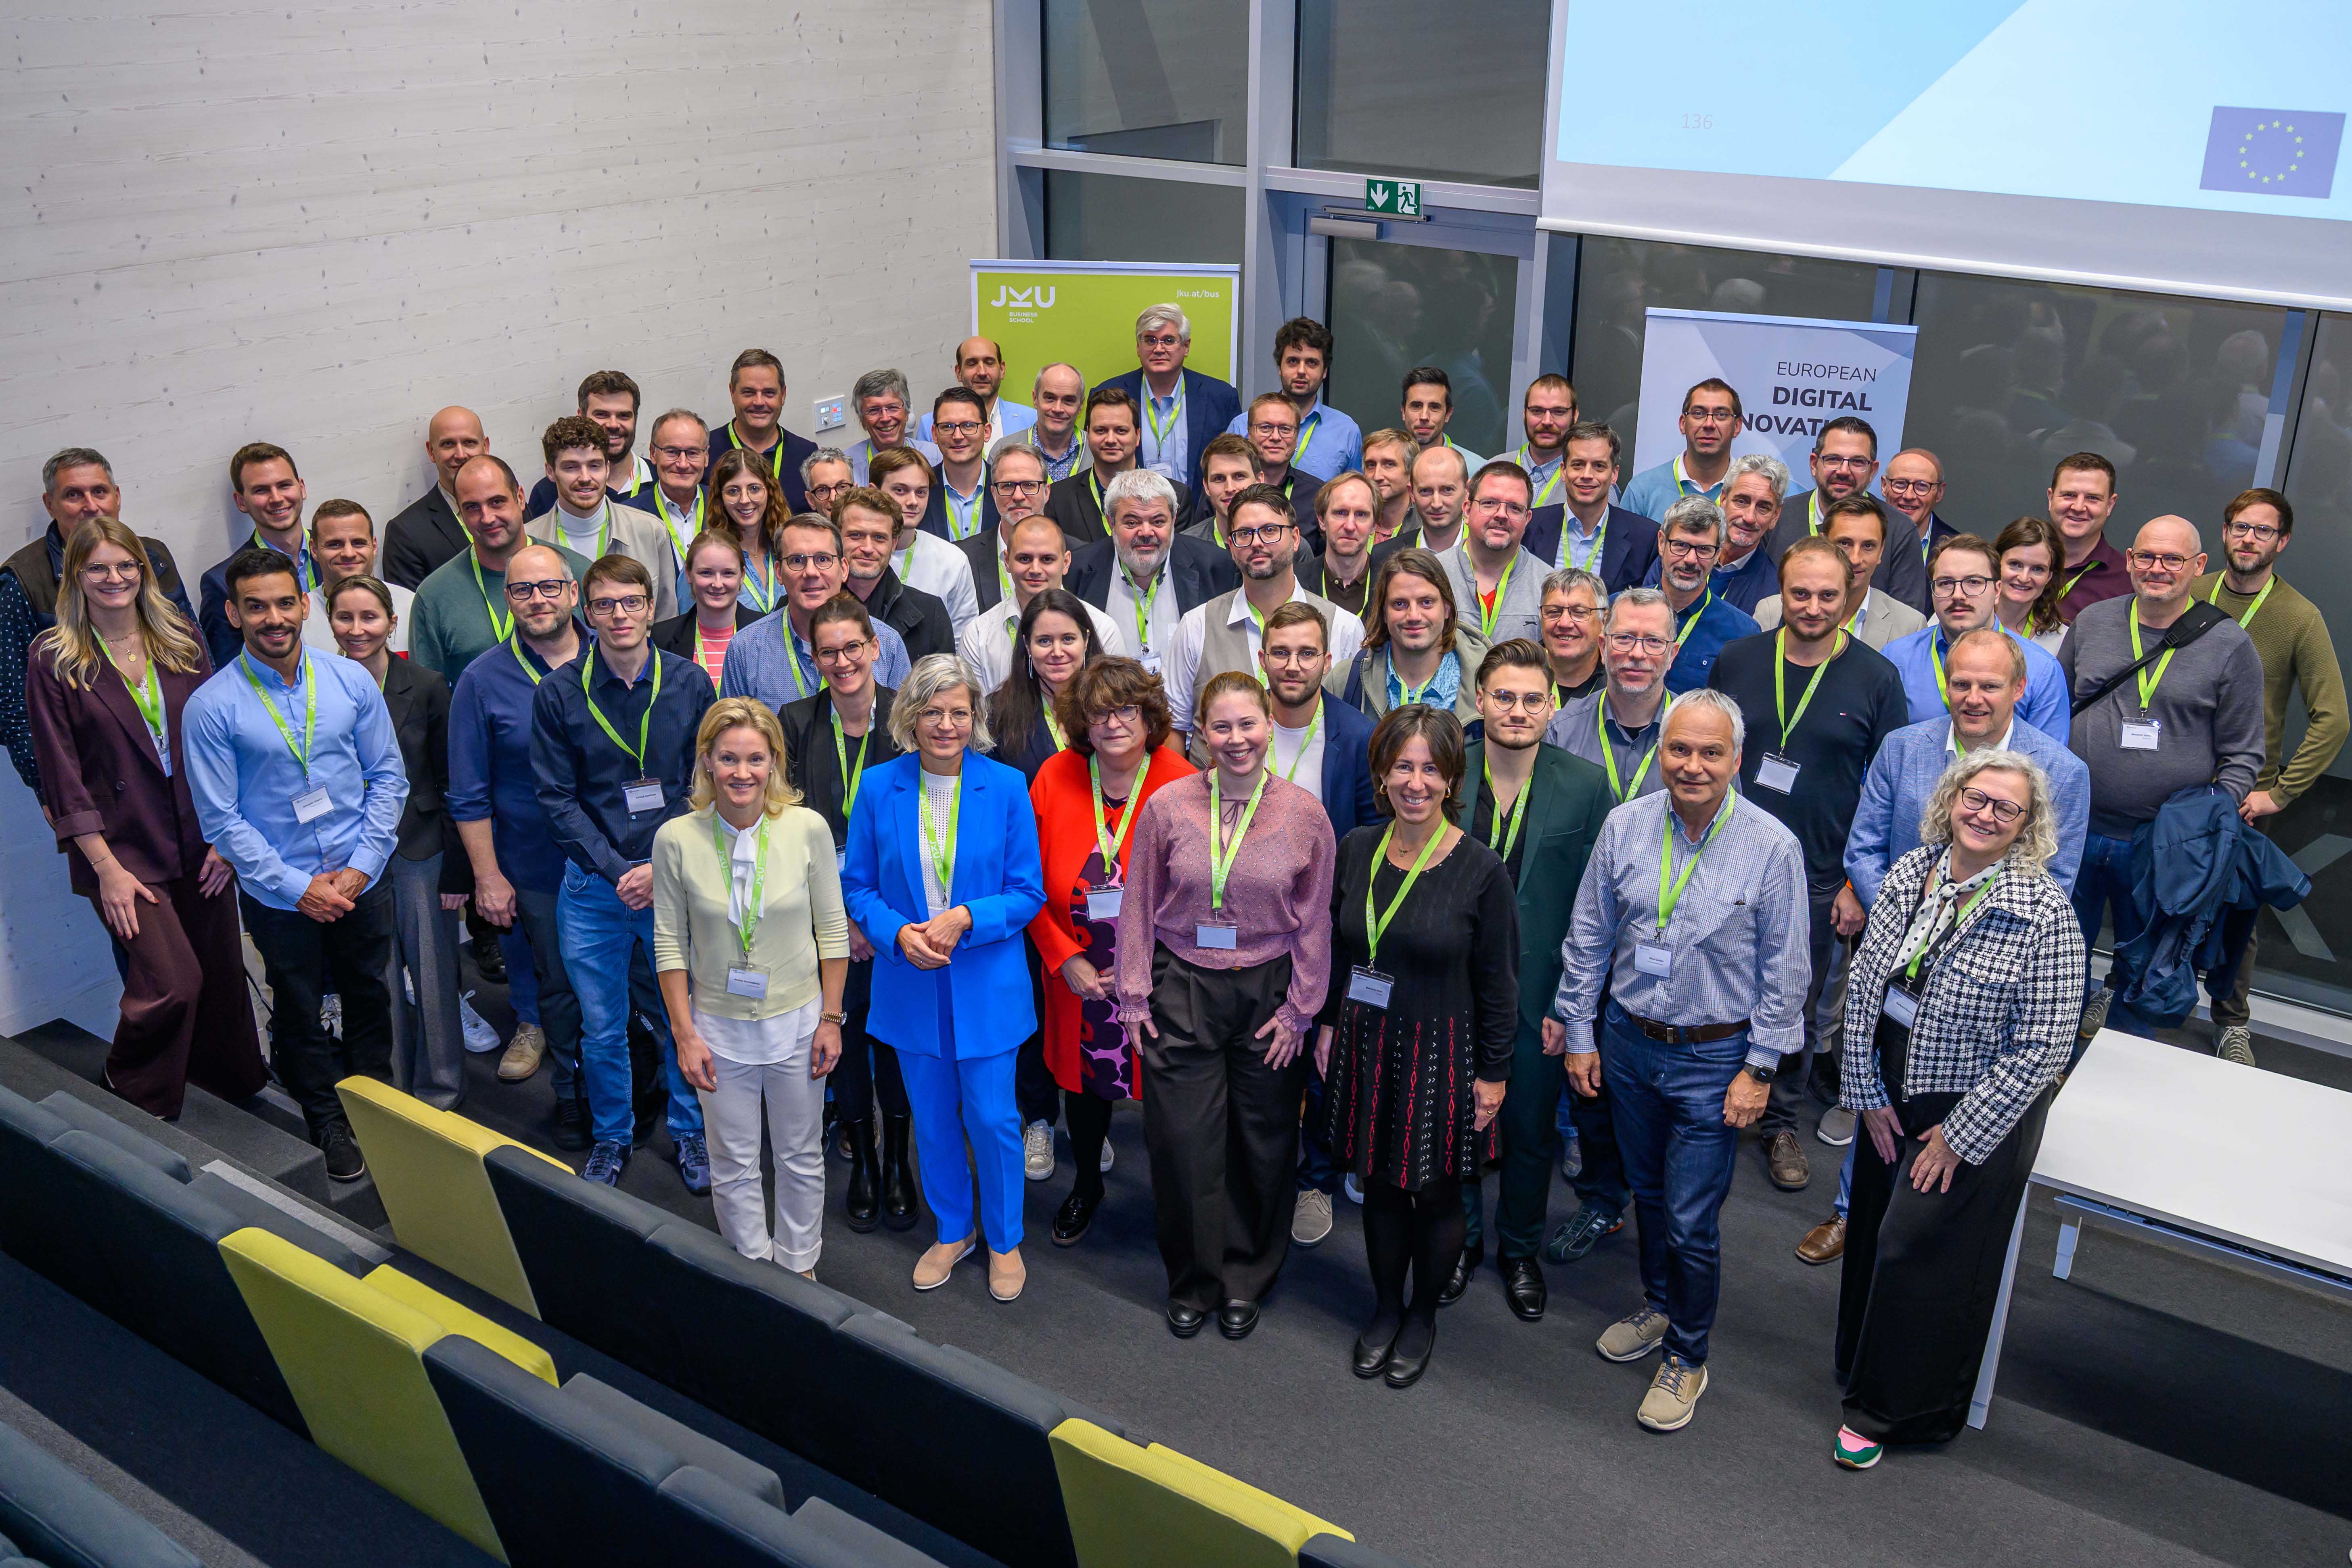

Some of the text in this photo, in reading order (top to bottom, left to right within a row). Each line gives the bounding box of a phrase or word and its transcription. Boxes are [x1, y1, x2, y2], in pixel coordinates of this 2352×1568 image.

[1681, 113, 1713, 130] 136
[991, 285, 1055, 308] JKU
[1176, 289, 1219, 298] jku.at/bus
[1777, 362, 1877, 382] EUROPEAN
[1772, 386, 1872, 411] DIGITAL
[2258, 587, 2269, 602] JKU
[789, 653, 798, 669] JKU
[1808, 676, 1820, 694] JKU
[255, 687, 270, 702] JKU
[1313, 708, 1323, 726] JKU
[280, 726, 295, 744] JKU
[1142, 753, 1151, 772] JKU
[1092, 777, 1101, 795] JKU
[919, 793, 929, 812] JKU
[1126, 796, 1135, 814] JKU
[1513, 799, 1524, 820] JKU
[1098, 822, 1106, 840] JKU
[1233, 829, 1244, 848] JKU
[930, 839, 940, 859] JKU
[1110, 839, 1120, 858] JKU
[718, 849, 728, 869] JKU
[756, 867, 764, 887] JKU
[1216, 875, 1226, 894] JKU
[748, 916, 756, 934] JKU
